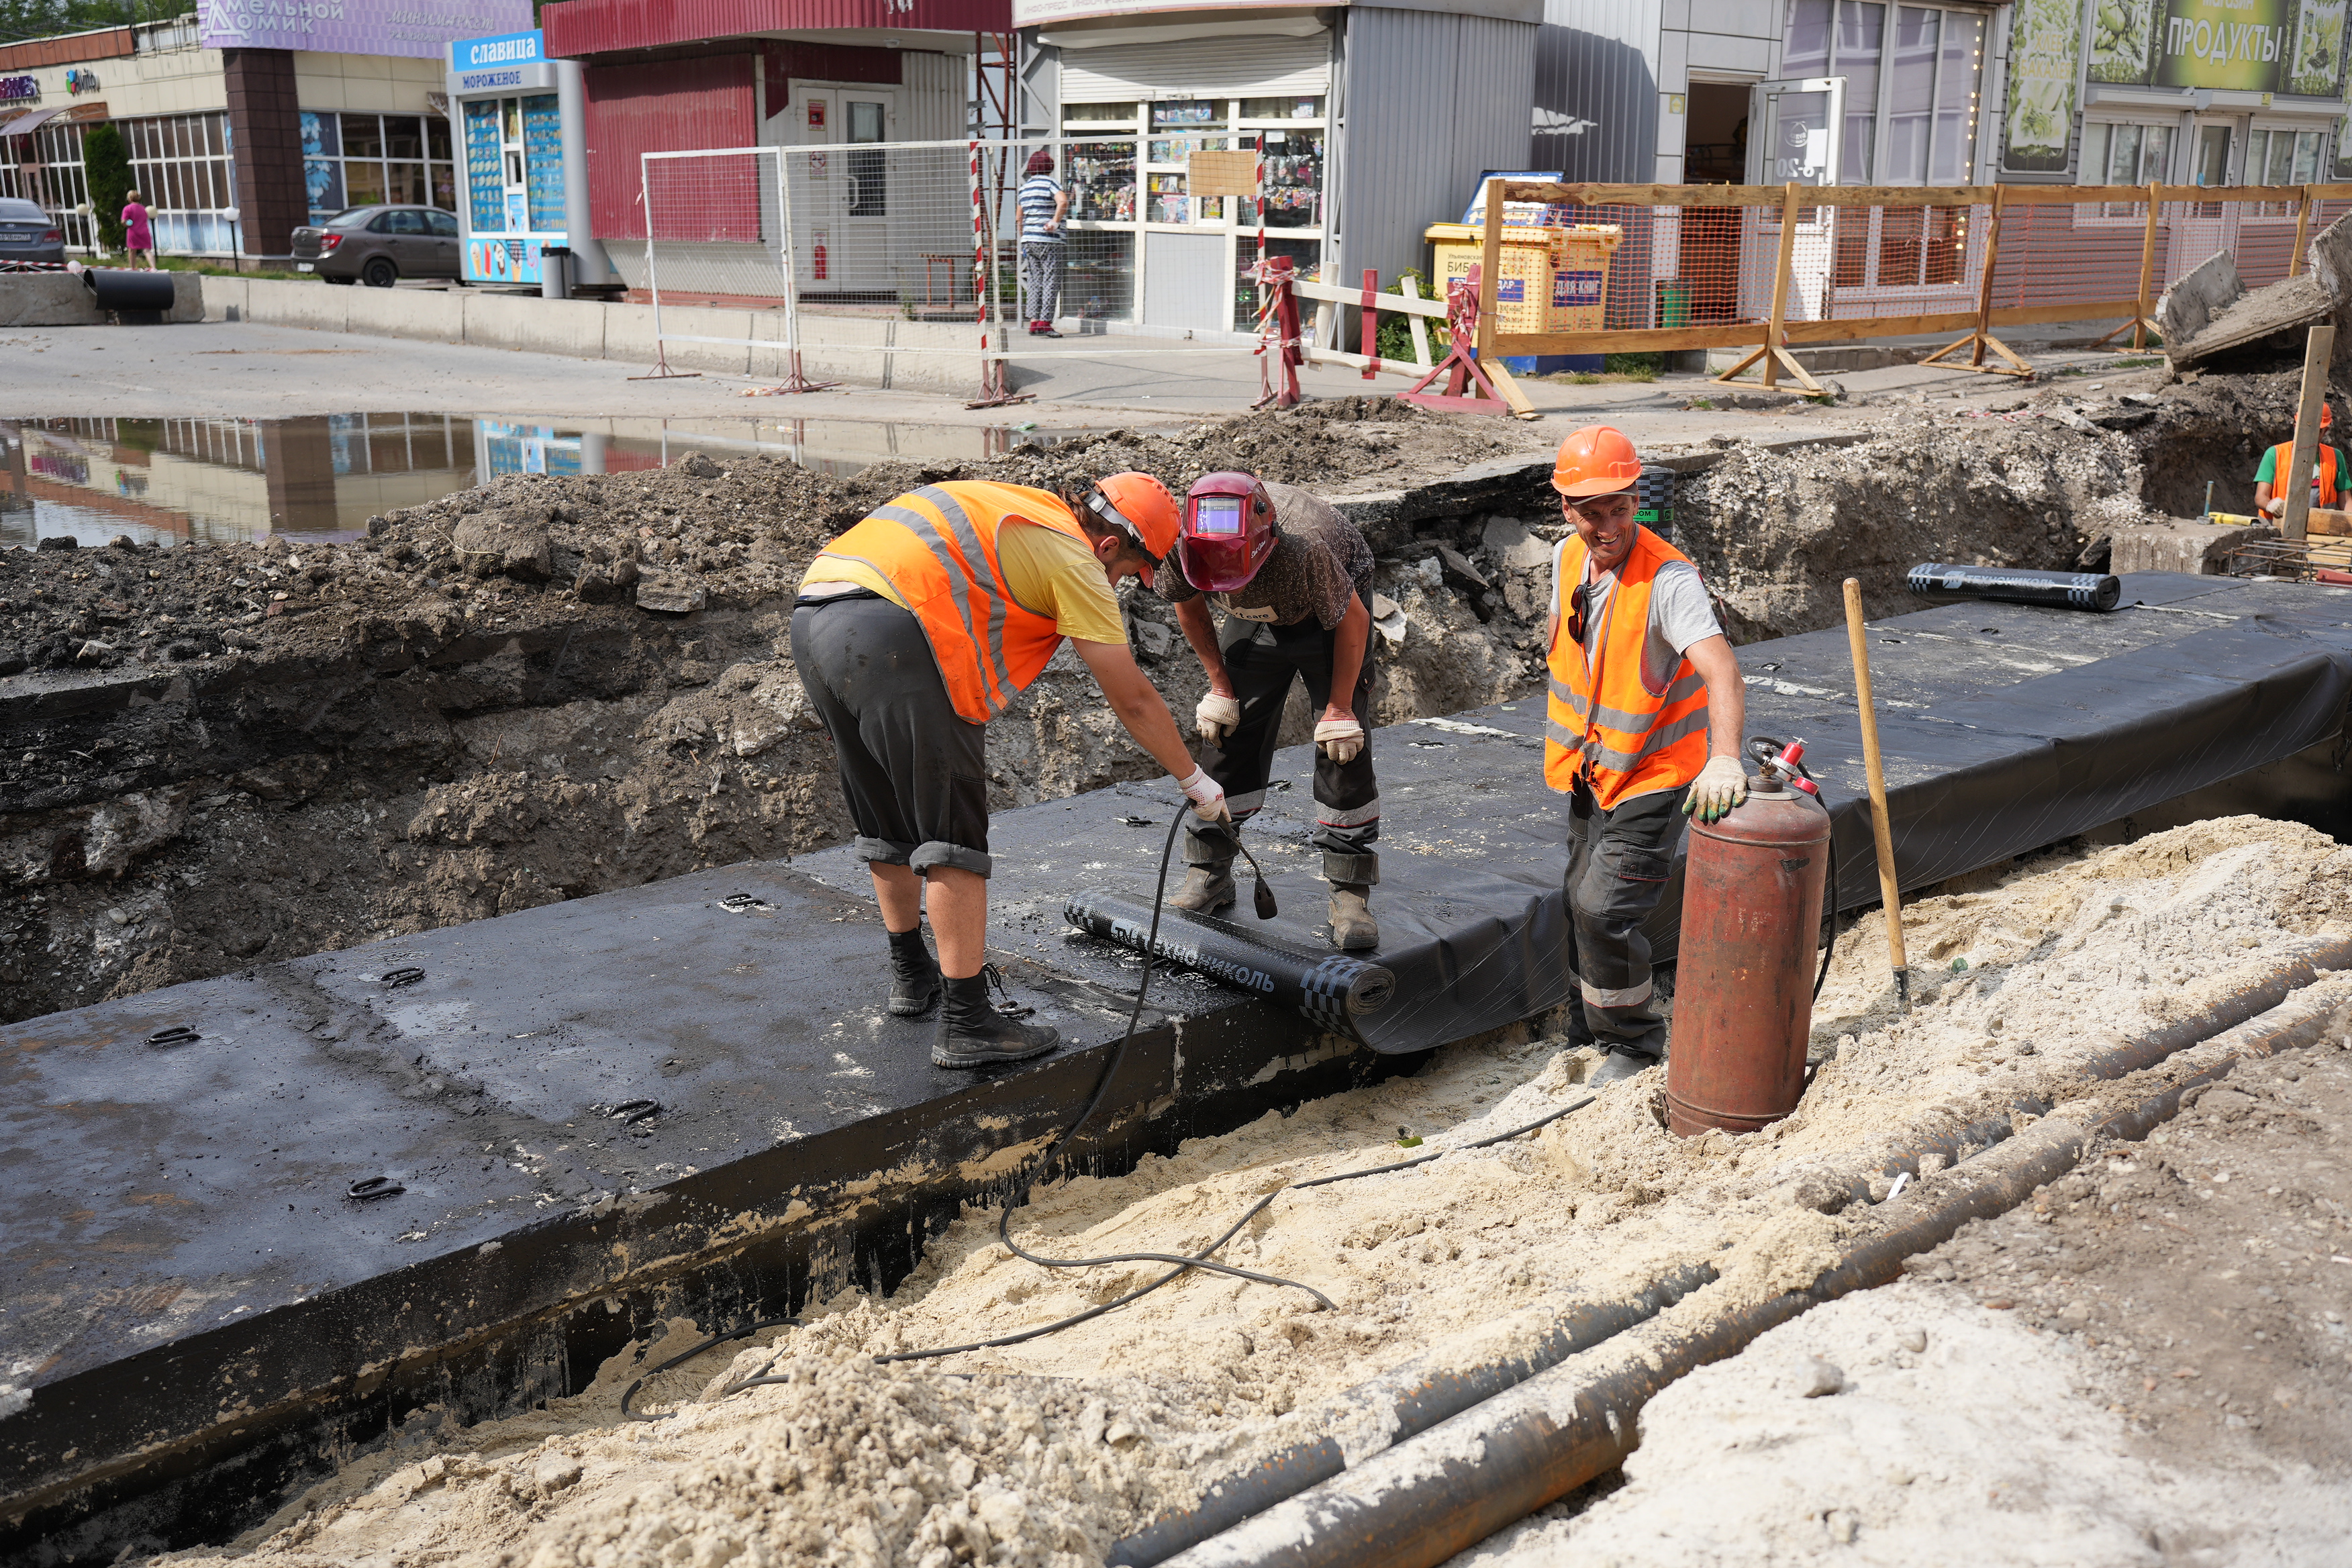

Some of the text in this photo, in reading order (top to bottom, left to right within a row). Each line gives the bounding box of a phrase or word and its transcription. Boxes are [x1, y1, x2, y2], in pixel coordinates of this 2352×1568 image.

[2034, 32, 2063, 52] ХЛЕБ
[2166, 16, 2283, 66] ПРОДУКТЫ
[2020, 58, 2072, 80] БАКАЛЕЯ
[462, 70, 522, 89] МОРОЖЕНОЕ
[1555, 280, 1600, 297] ДЛЯ КНИГ
